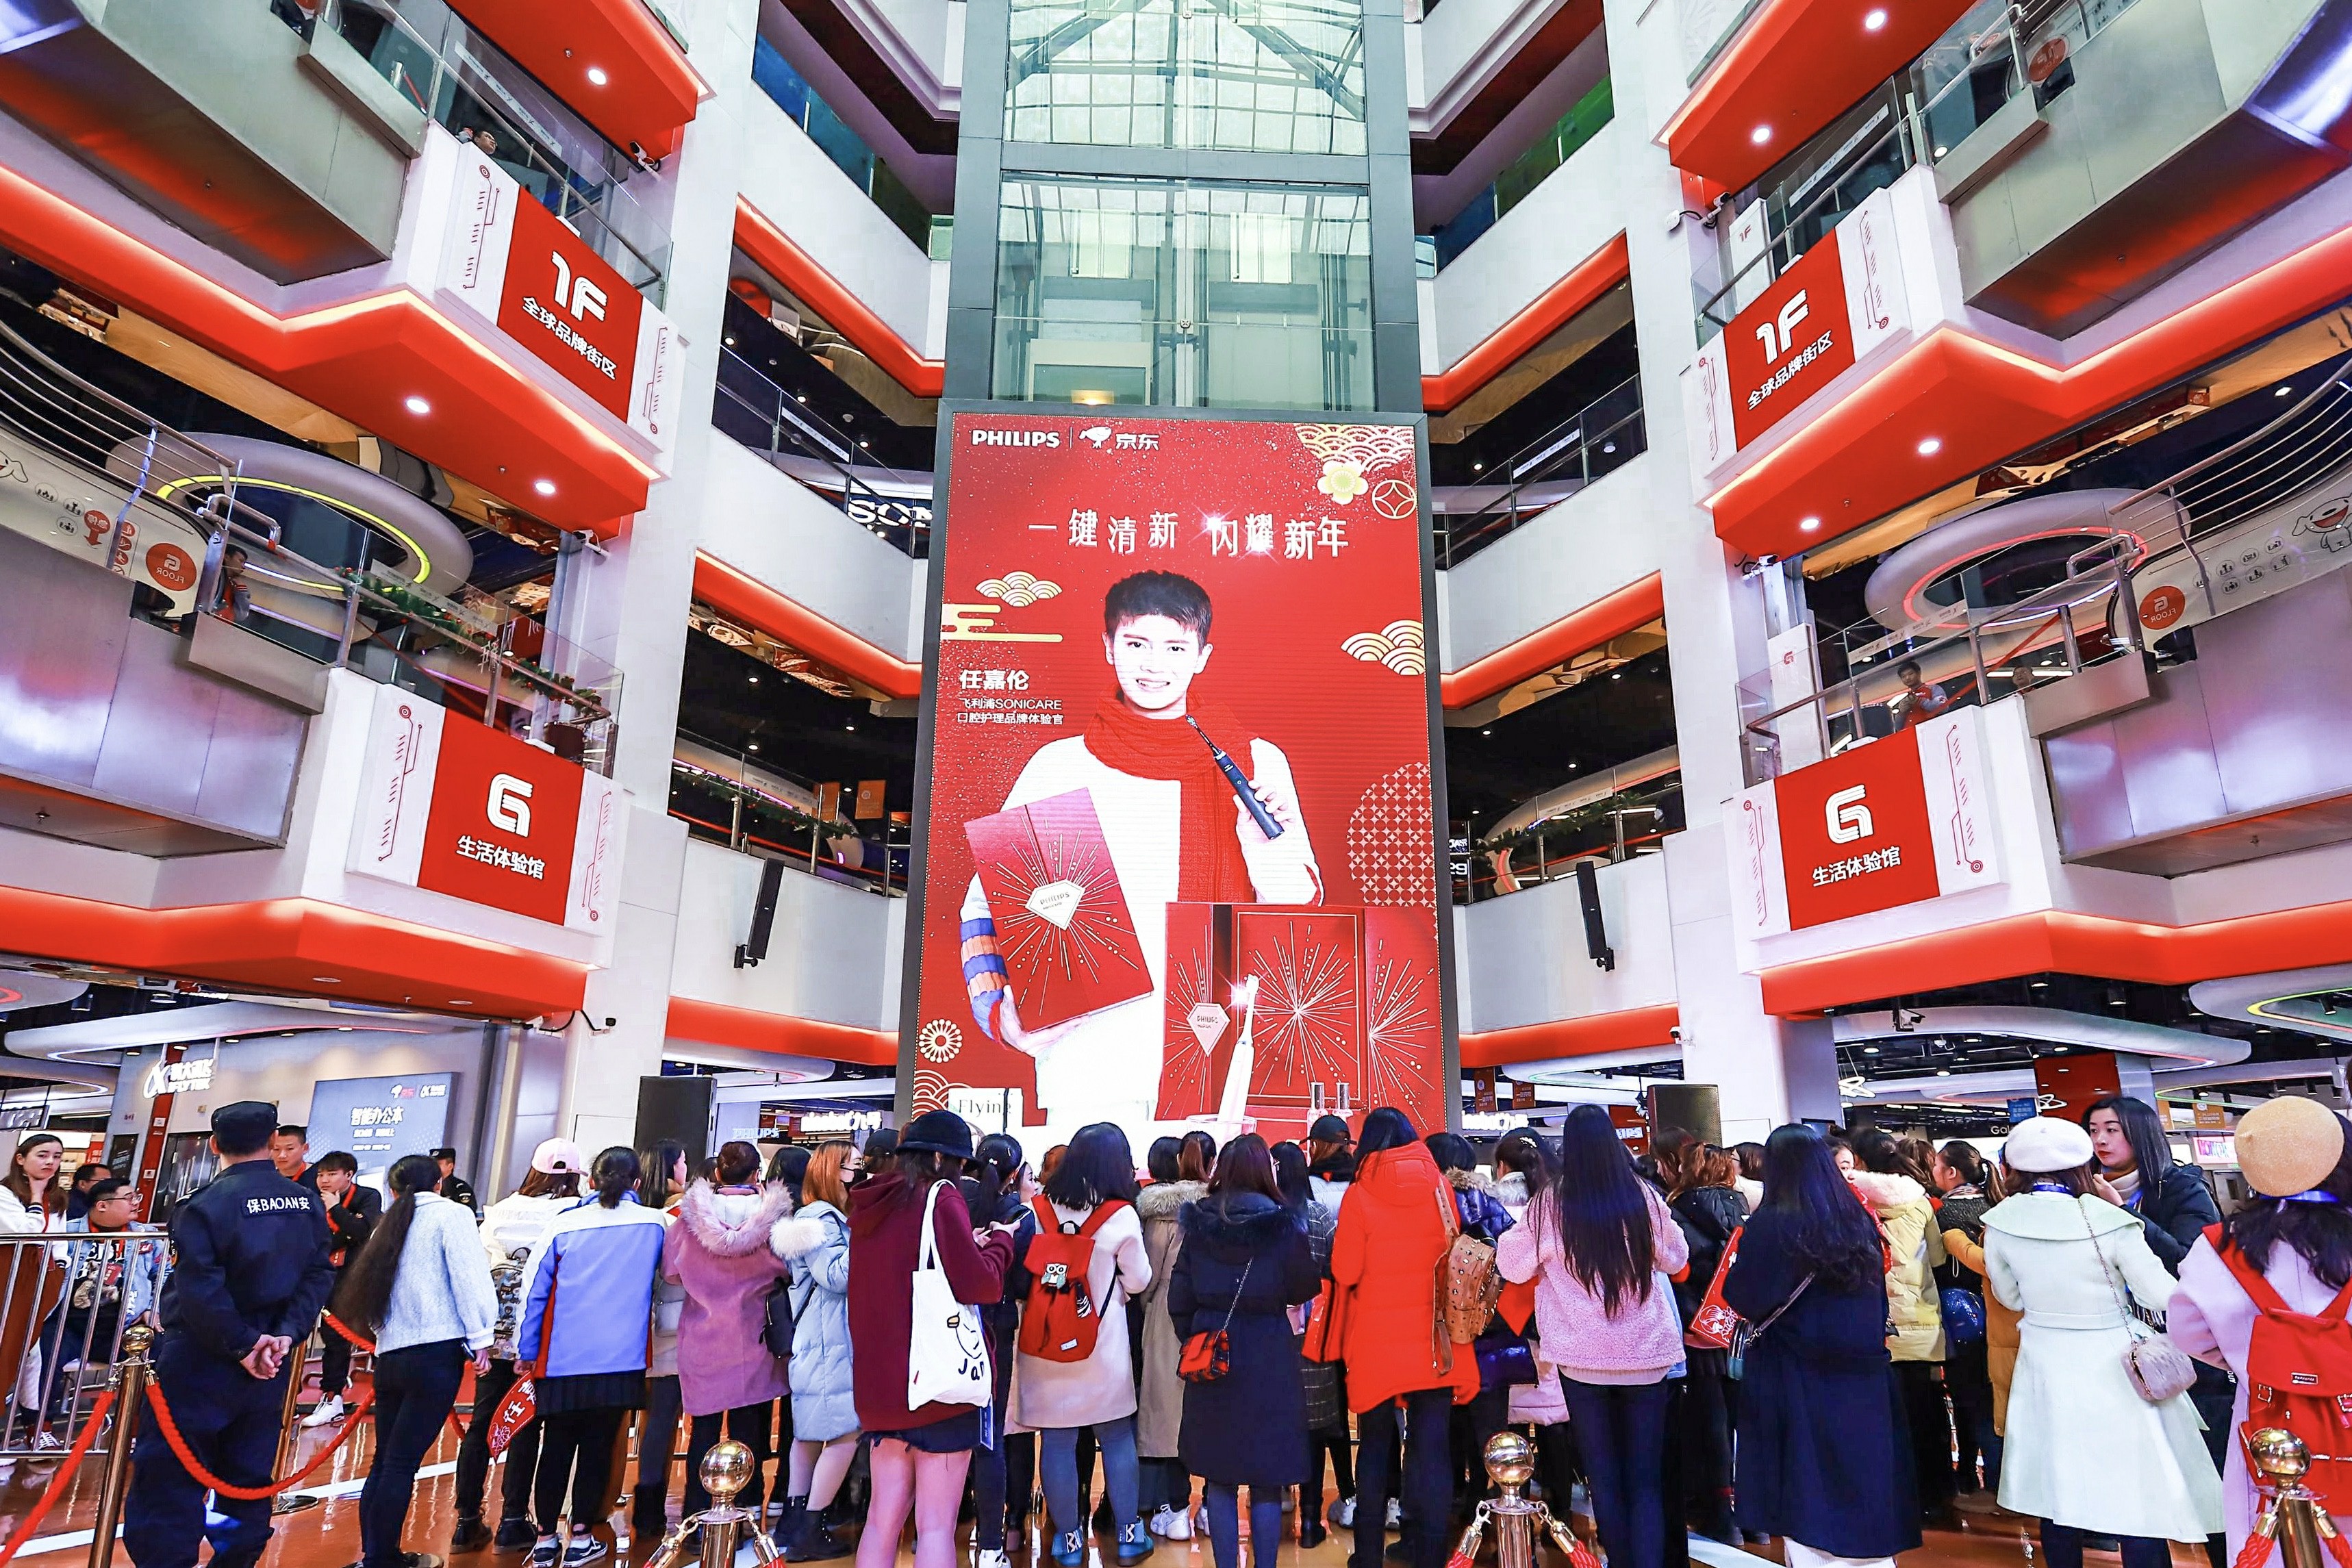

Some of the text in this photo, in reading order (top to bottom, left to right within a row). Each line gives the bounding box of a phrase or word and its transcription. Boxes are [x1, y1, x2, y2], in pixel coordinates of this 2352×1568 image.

[1739, 225, 1752, 242] 1F
[551, 251, 608, 322] 1F
[522, 296, 618, 381] 全球品牌街区
[1756, 289, 1809, 365] 1F
[1747, 329, 1834, 411] 全球品牌街区
[971, 429, 1061, 448] PHILIPS
[1115, 432, 1160, 451] 京东
[1028, 507, 1350, 561] 一键清新 闪耀新年
[959, 668, 1030, 691] 任嘉伦
[957, 711, 1064, 726] 口腔护理品牌体验官
[959, 696, 1063, 711] 飞利浦SONICARE
[455, 835, 546, 881] 生活体验馆
[1812, 845, 1901, 887] 生活体验馆
[246, 1196, 311, 1214] 保BAOAN安
